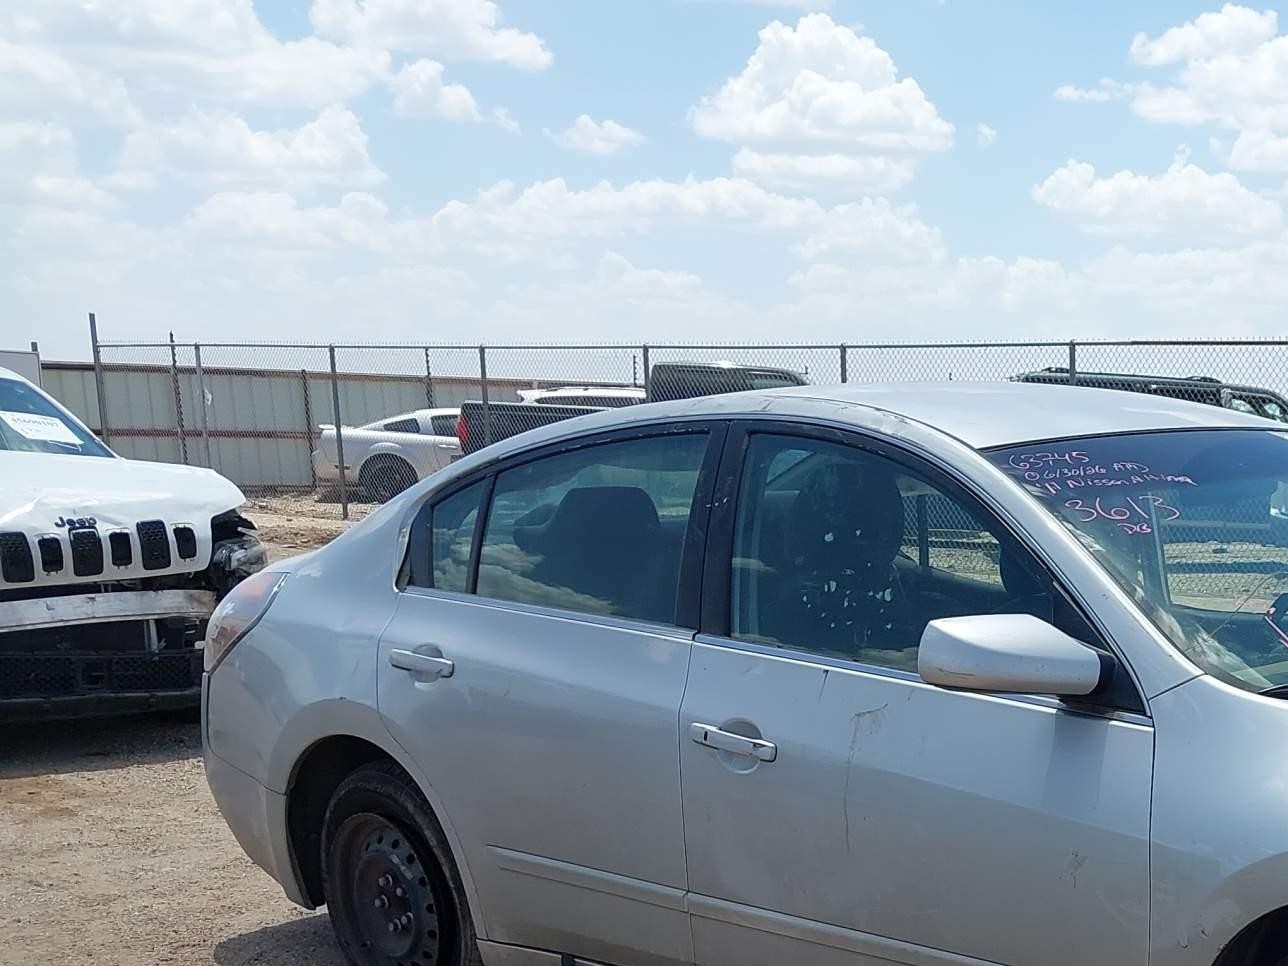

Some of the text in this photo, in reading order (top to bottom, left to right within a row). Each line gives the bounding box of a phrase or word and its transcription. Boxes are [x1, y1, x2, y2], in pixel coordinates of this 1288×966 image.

[1009, 451, 1090, 469] 63745
[1024, 465, 1107, 481] 06/30/26
[1065, 497, 1180, 521] 3613
[54, 516, 97, 527] Jeep
